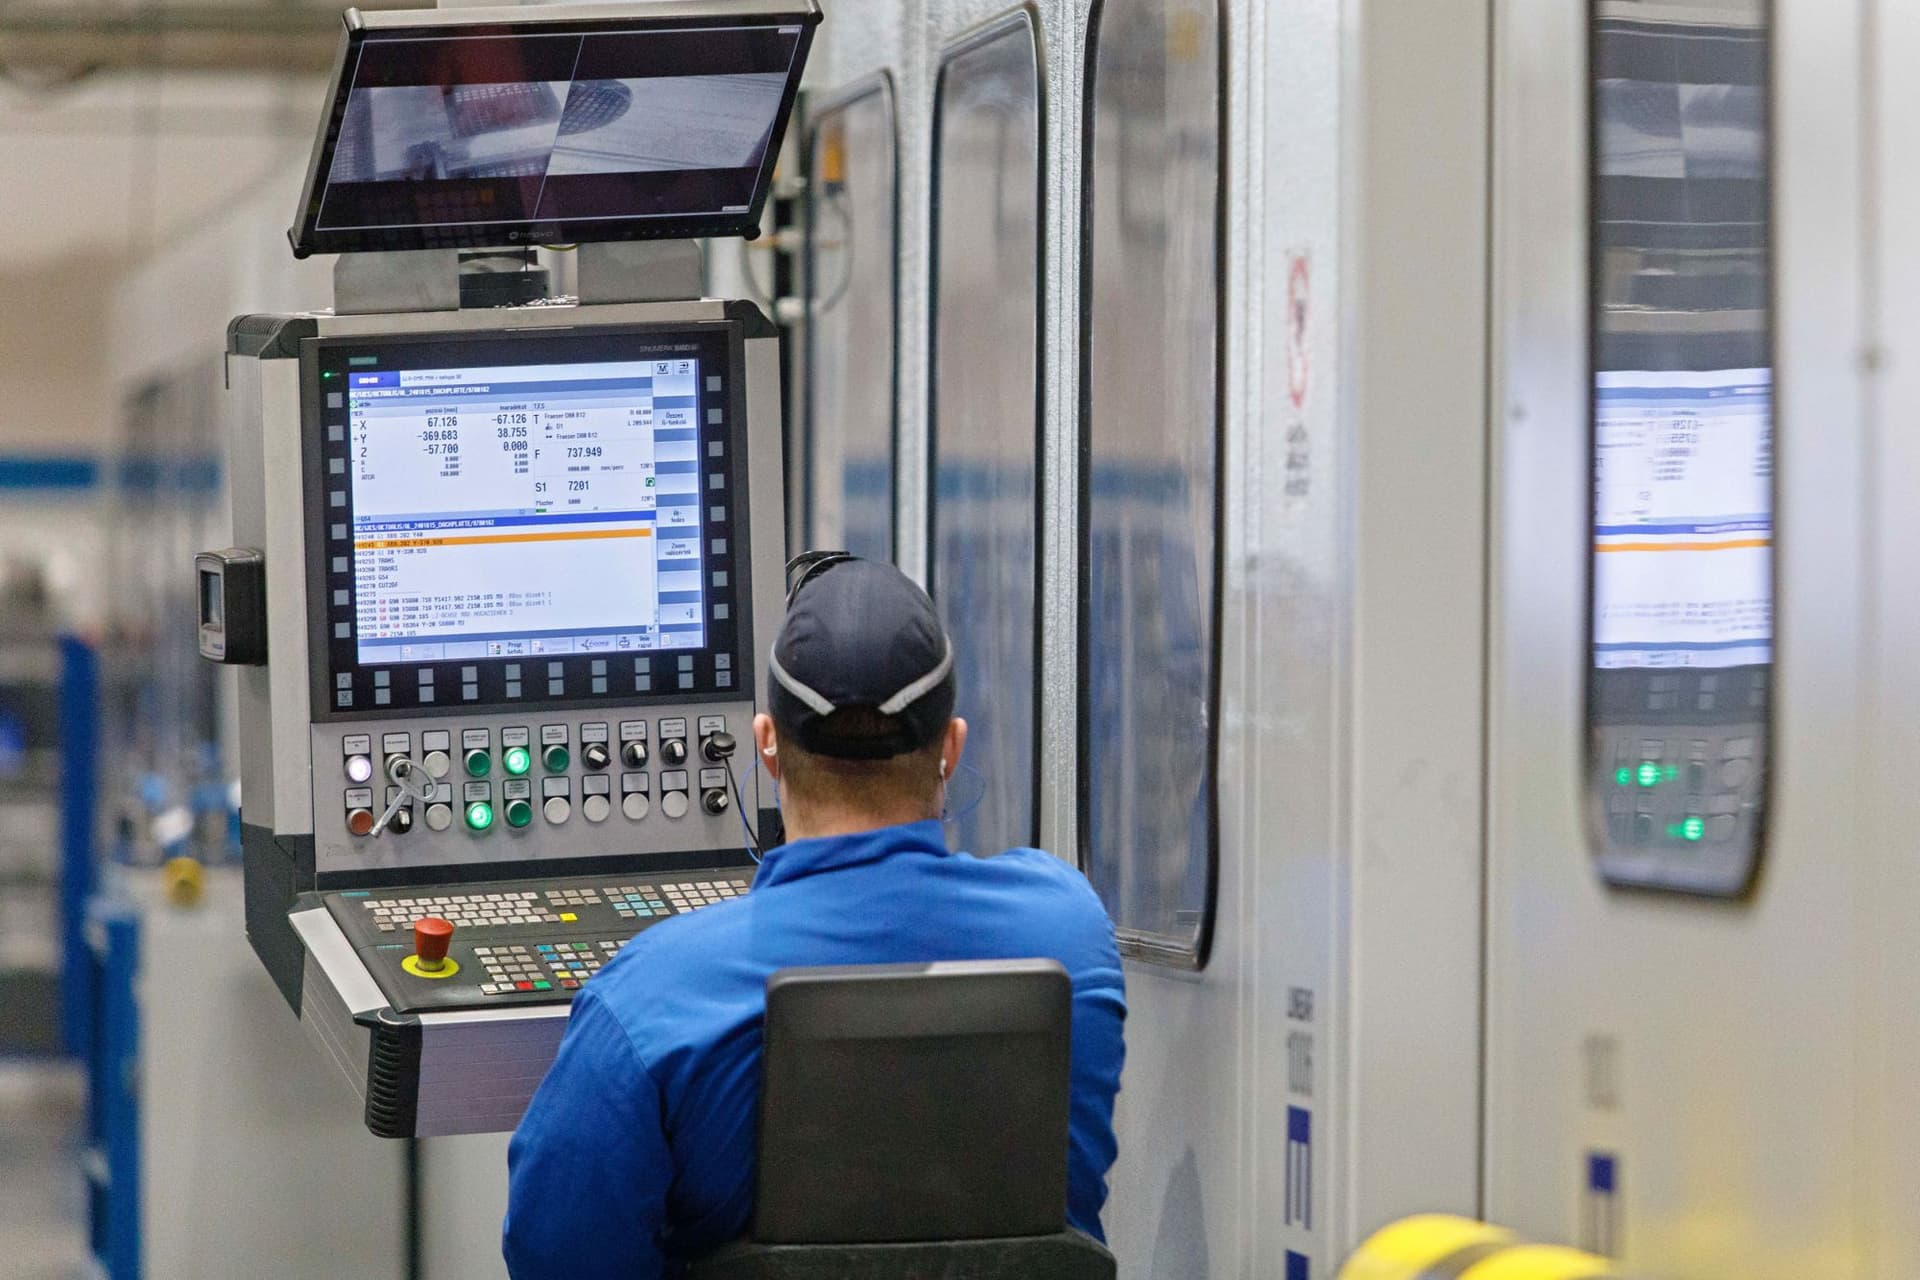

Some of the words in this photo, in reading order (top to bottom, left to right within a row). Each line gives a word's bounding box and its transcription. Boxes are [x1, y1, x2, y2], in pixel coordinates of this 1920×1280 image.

[427, 416, 458, 428] 67.126
[491, 413, 527, 425] -67.126
[533, 414, 539, 424] T
[417, 430, 458, 441] -369.683
[498, 427, 527, 438] 38.755
[423, 443, 459, 455] -57.700
[503, 441, 528, 451] 0.000
[535, 449, 540, 459] F
[567, 447, 602, 458] 737.949
[535, 482, 547, 492] S1
[568, 480, 589, 491] 7201
